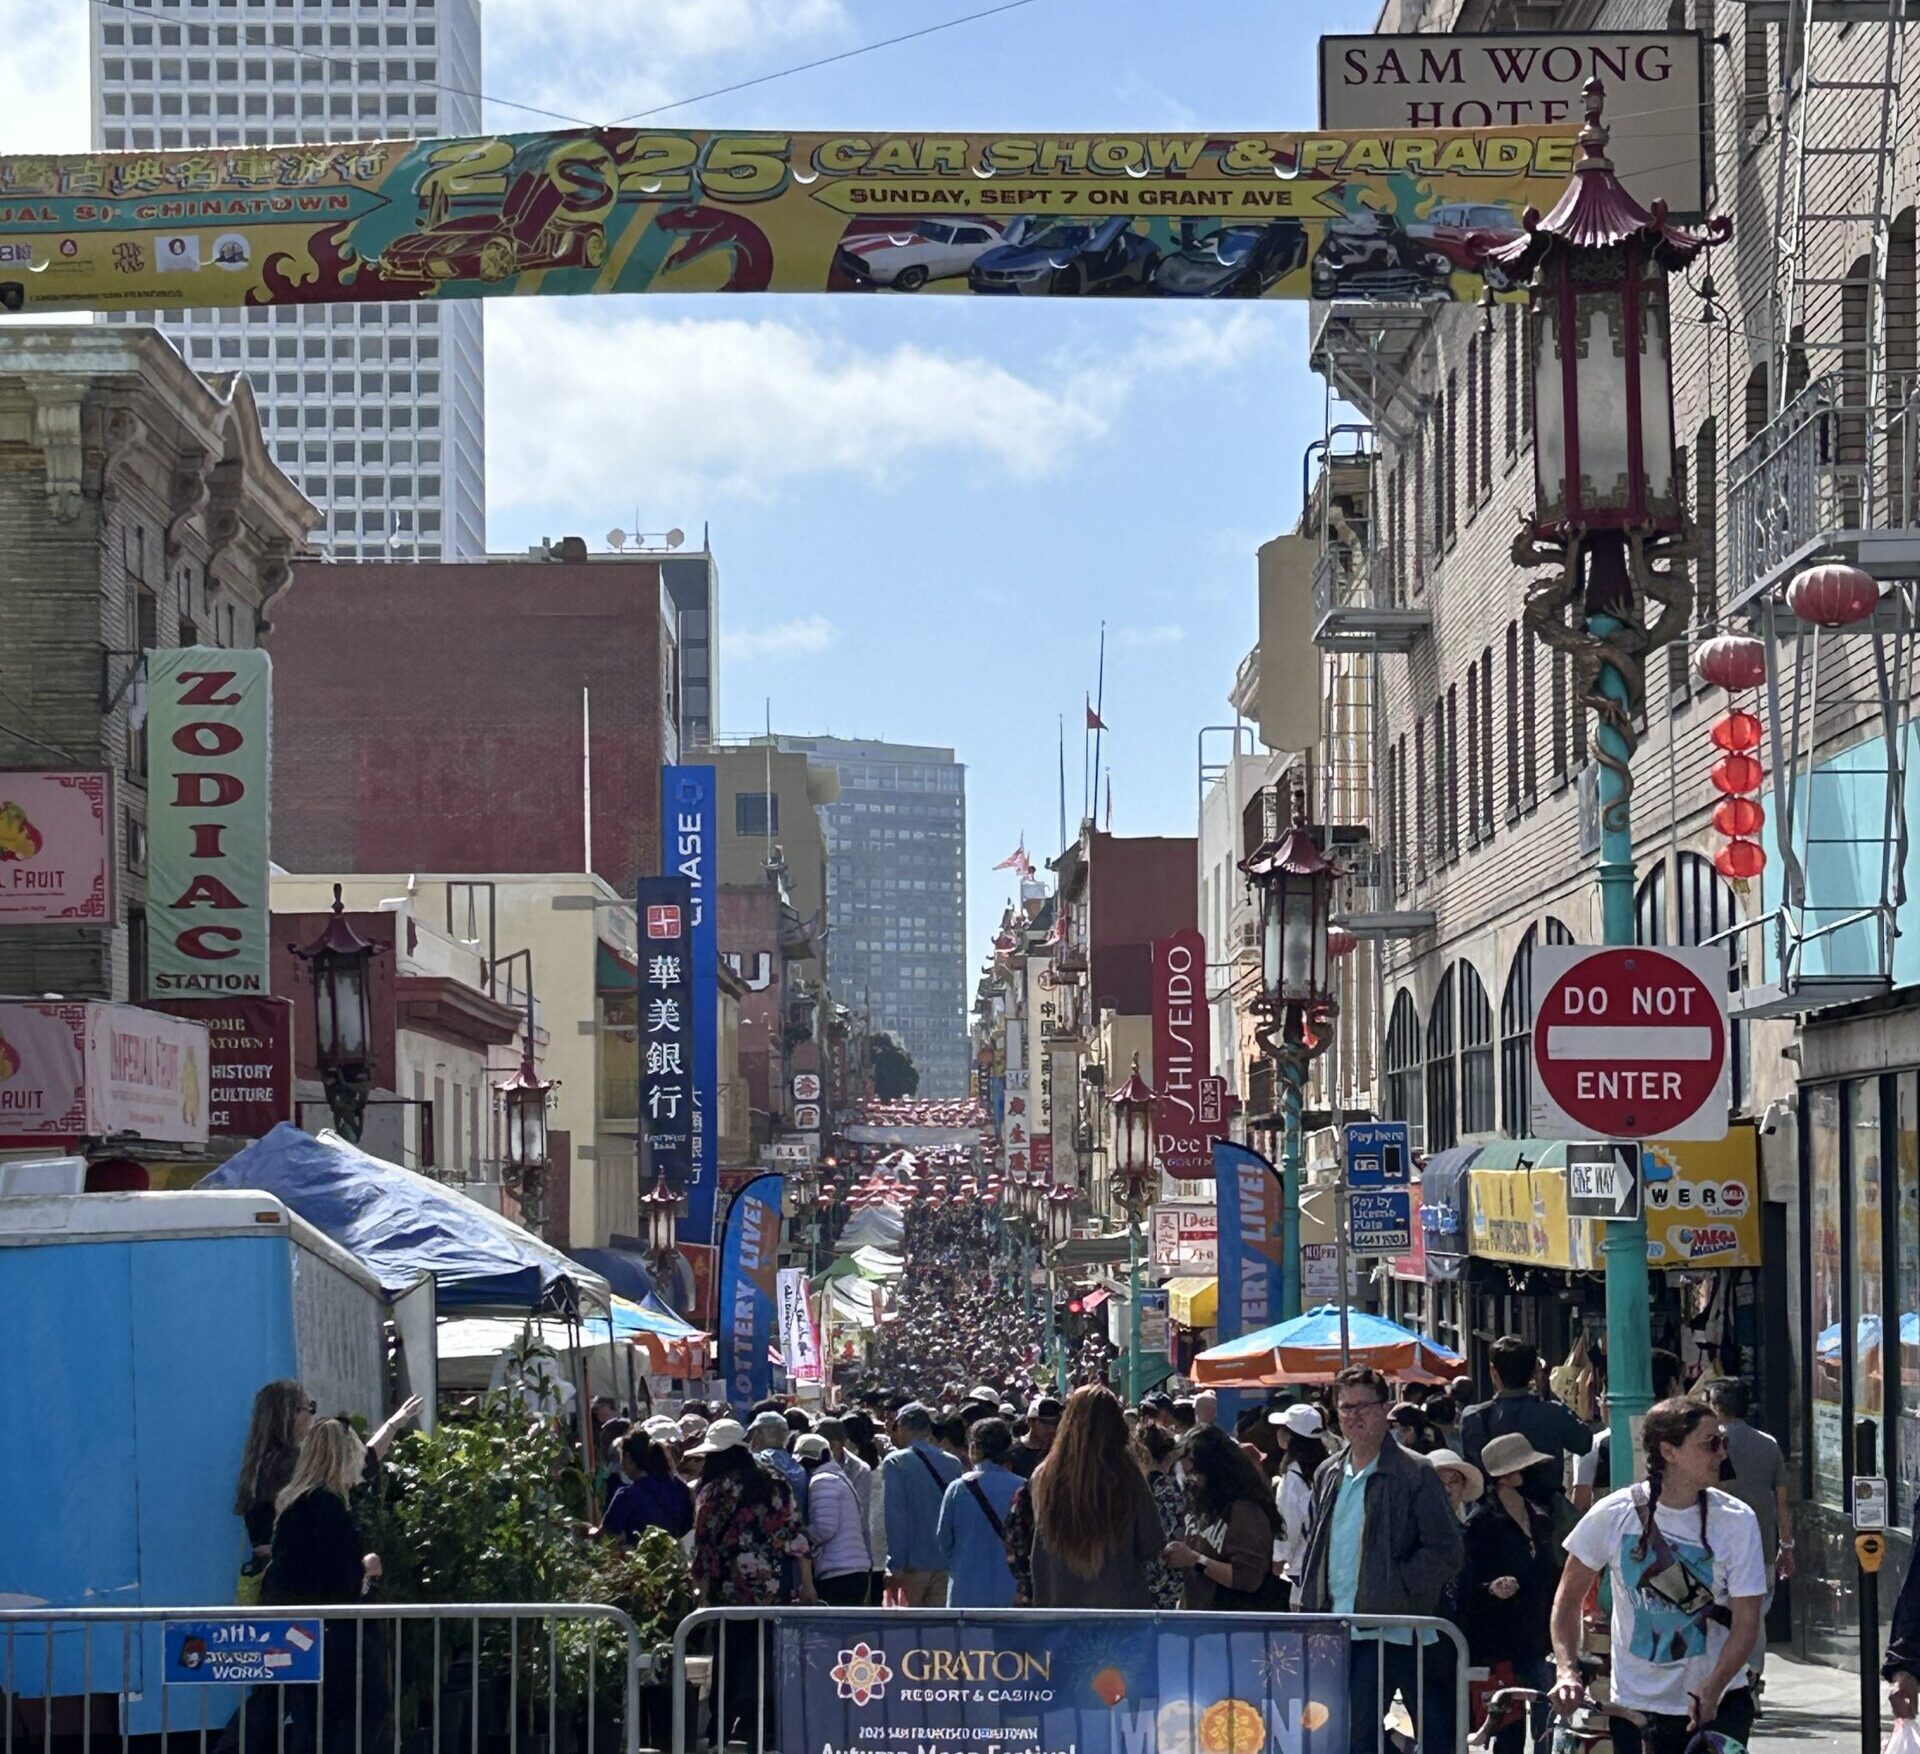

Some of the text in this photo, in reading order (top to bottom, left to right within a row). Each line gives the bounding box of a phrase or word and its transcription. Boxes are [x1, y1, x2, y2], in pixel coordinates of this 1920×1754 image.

[1344, 45, 1672, 86] SAM WONG
[1407, 99, 1584, 128] HOTE
[812, 137, 1577, 178] CAR SHOW & PARADE
[135, 196, 349, 221] CHINATOWN
[849, 187, 1292, 207] SUNDAY, SEPT 7 ON GRANT AVE
[170, 671, 249, 960] ZODIAC
[156, 973, 260, 990] STATION
[1564, 986, 1696, 1015] DO NOT
[647, 954, 683, 1120] 華美銀行
[1167, 946, 1195, 1124] SHISEIDO
[211, 1064, 274, 1079] HISTORY
[1577, 1071, 1683, 1100] ENTER
[211, 1087, 274, 1102] CULTURE
[209, 1111, 231, 1126] CE
[1350, 1130, 1374, 1145] Pay
[1572, 1166, 1616, 1194] ONE WAY
[1237, 1163, 1267, 1243] LIVE!
[1352, 1194, 1392, 1209] Pay by
[212, 1666, 274, 1680] WORKS
[901, 1649, 1052, 1682] GRATON
[901, 1689, 1053, 1701] RESORT & CASINO
